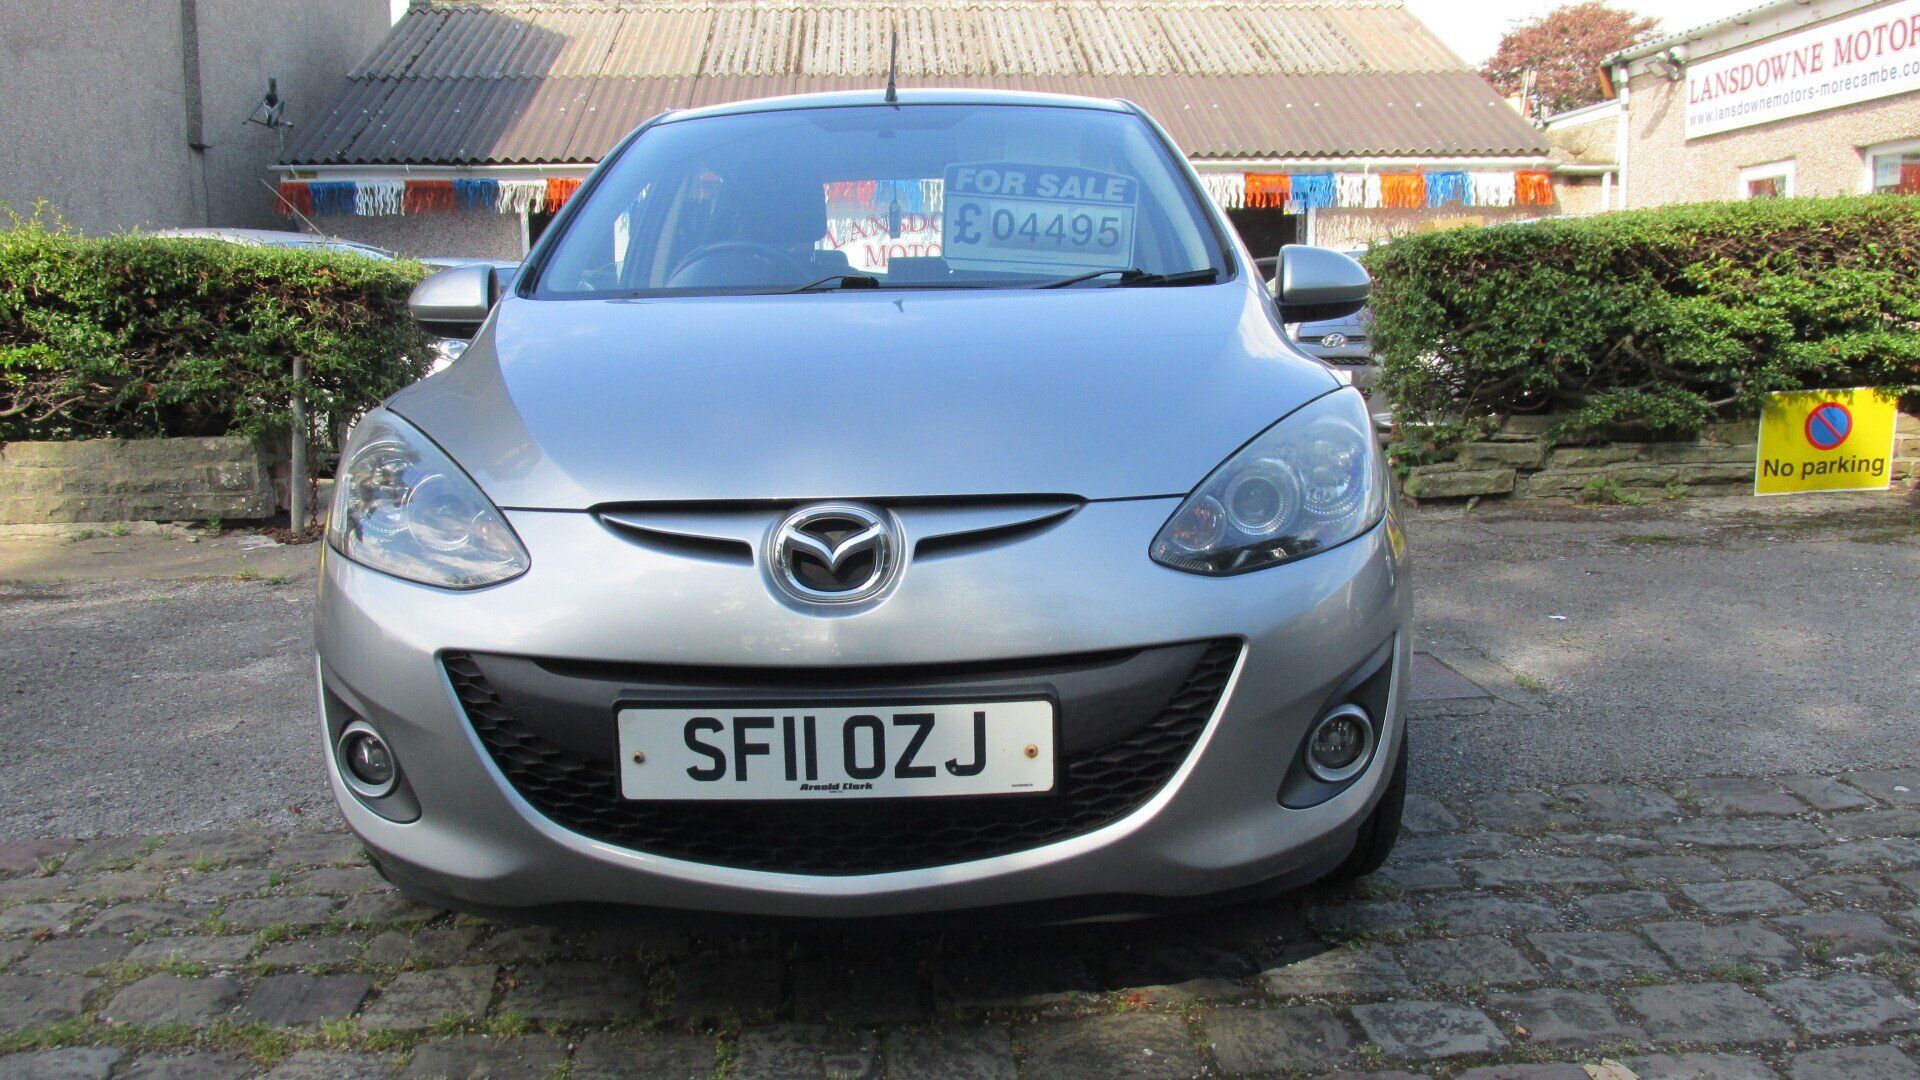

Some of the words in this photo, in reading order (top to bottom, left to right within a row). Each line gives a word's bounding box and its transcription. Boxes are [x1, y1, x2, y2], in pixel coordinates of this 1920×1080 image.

[1689, 42, 1824, 105] LANSDOWNE
[956, 168, 1026, 195] FOR
[1036, 173, 1128, 200] SALE
[1763, 458, 1794, 477] No
[1801, 455, 1885, 480] parking
[683, 715, 819, 782] SF11
[842, 711, 987, 780] OZJ
